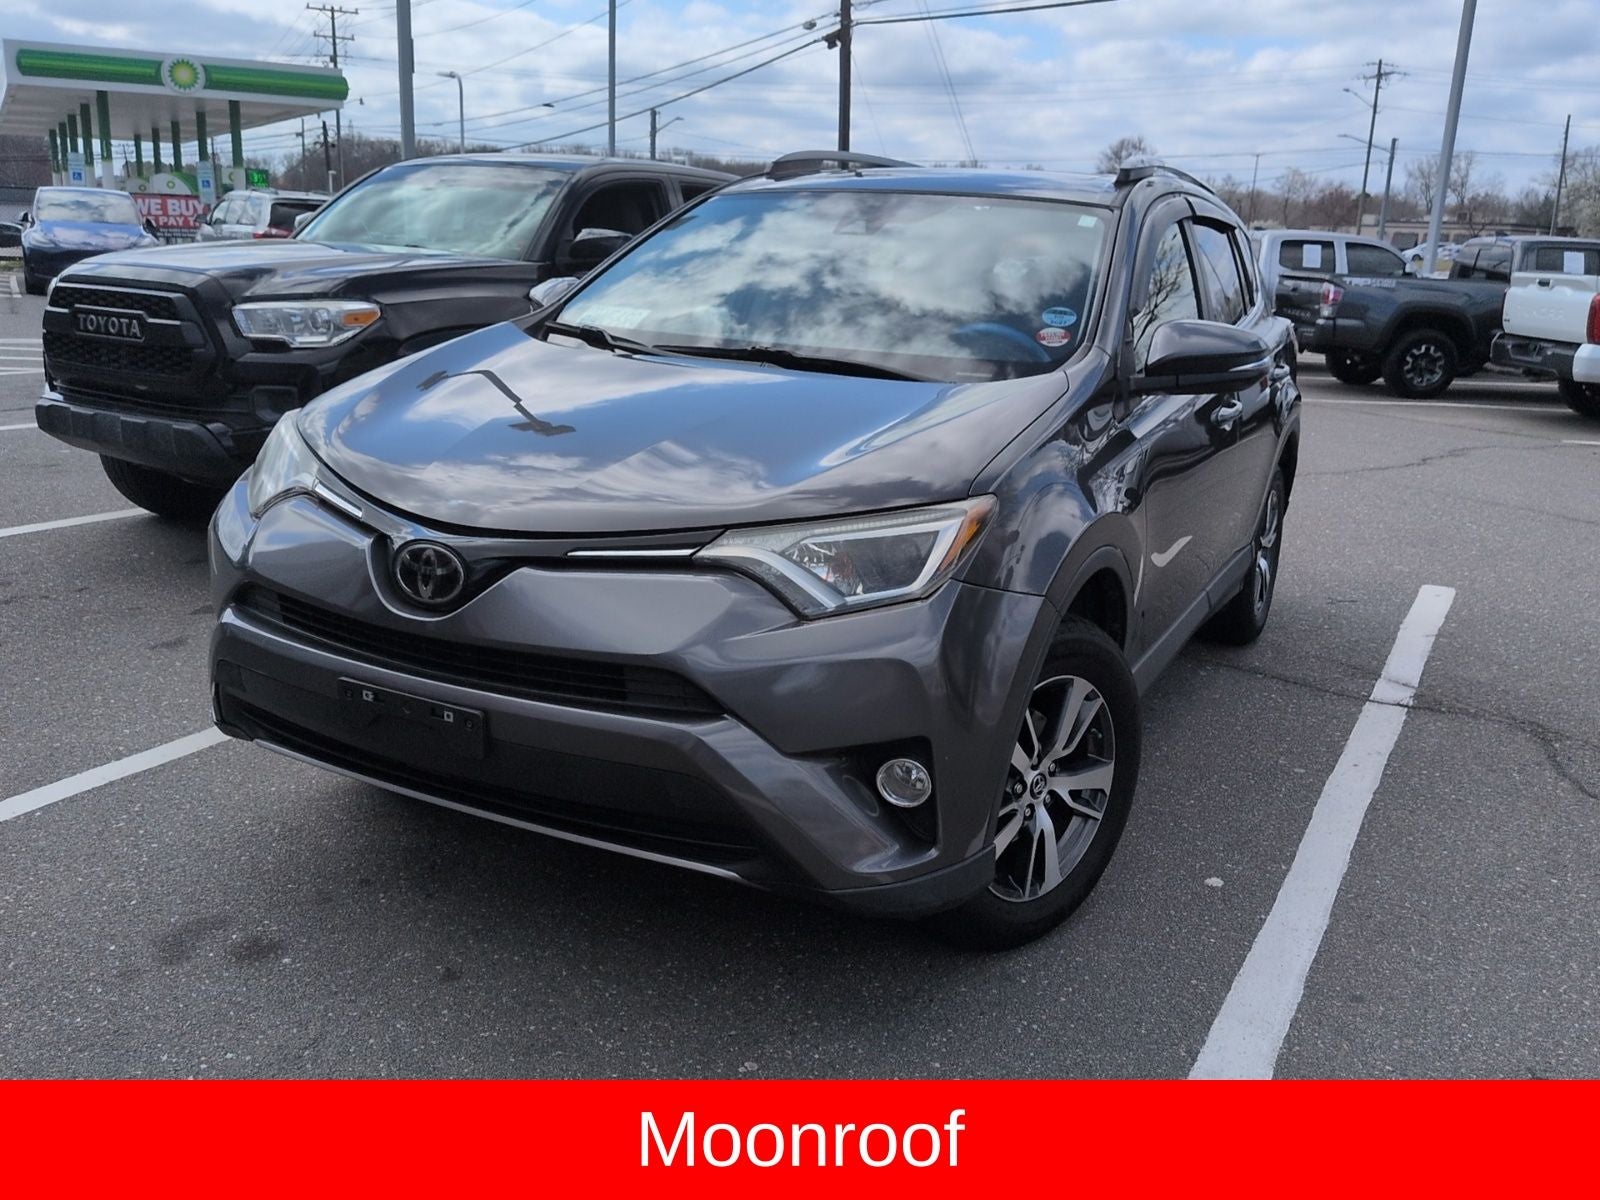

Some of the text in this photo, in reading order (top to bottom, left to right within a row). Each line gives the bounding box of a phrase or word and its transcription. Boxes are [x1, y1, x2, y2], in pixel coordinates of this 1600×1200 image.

[167, 198, 204, 216] BUY
[159, 216, 185, 226] PAY
[77, 314, 141, 338] TOYOTA
